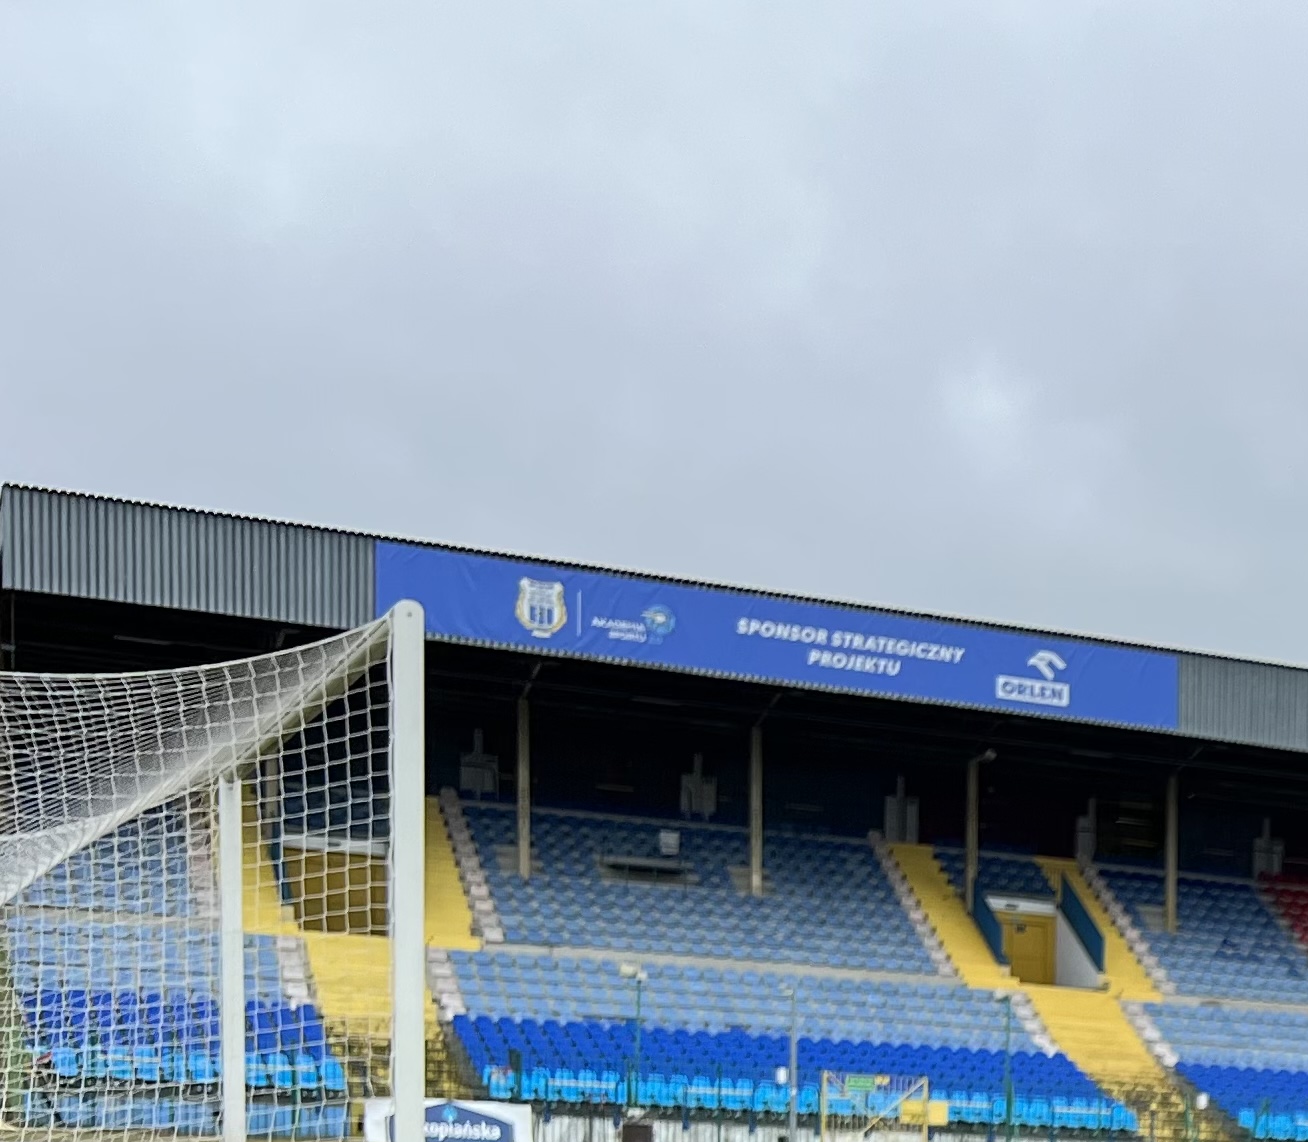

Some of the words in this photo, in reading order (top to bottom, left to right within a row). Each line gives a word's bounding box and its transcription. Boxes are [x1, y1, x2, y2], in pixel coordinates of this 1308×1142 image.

[736, 617, 828, 645] SPONSOR
[831, 630, 966, 664] STRATEGICZNY
[807, 648, 901, 676] PROJEKTU
[1002, 681, 1064, 700] ORLEN
